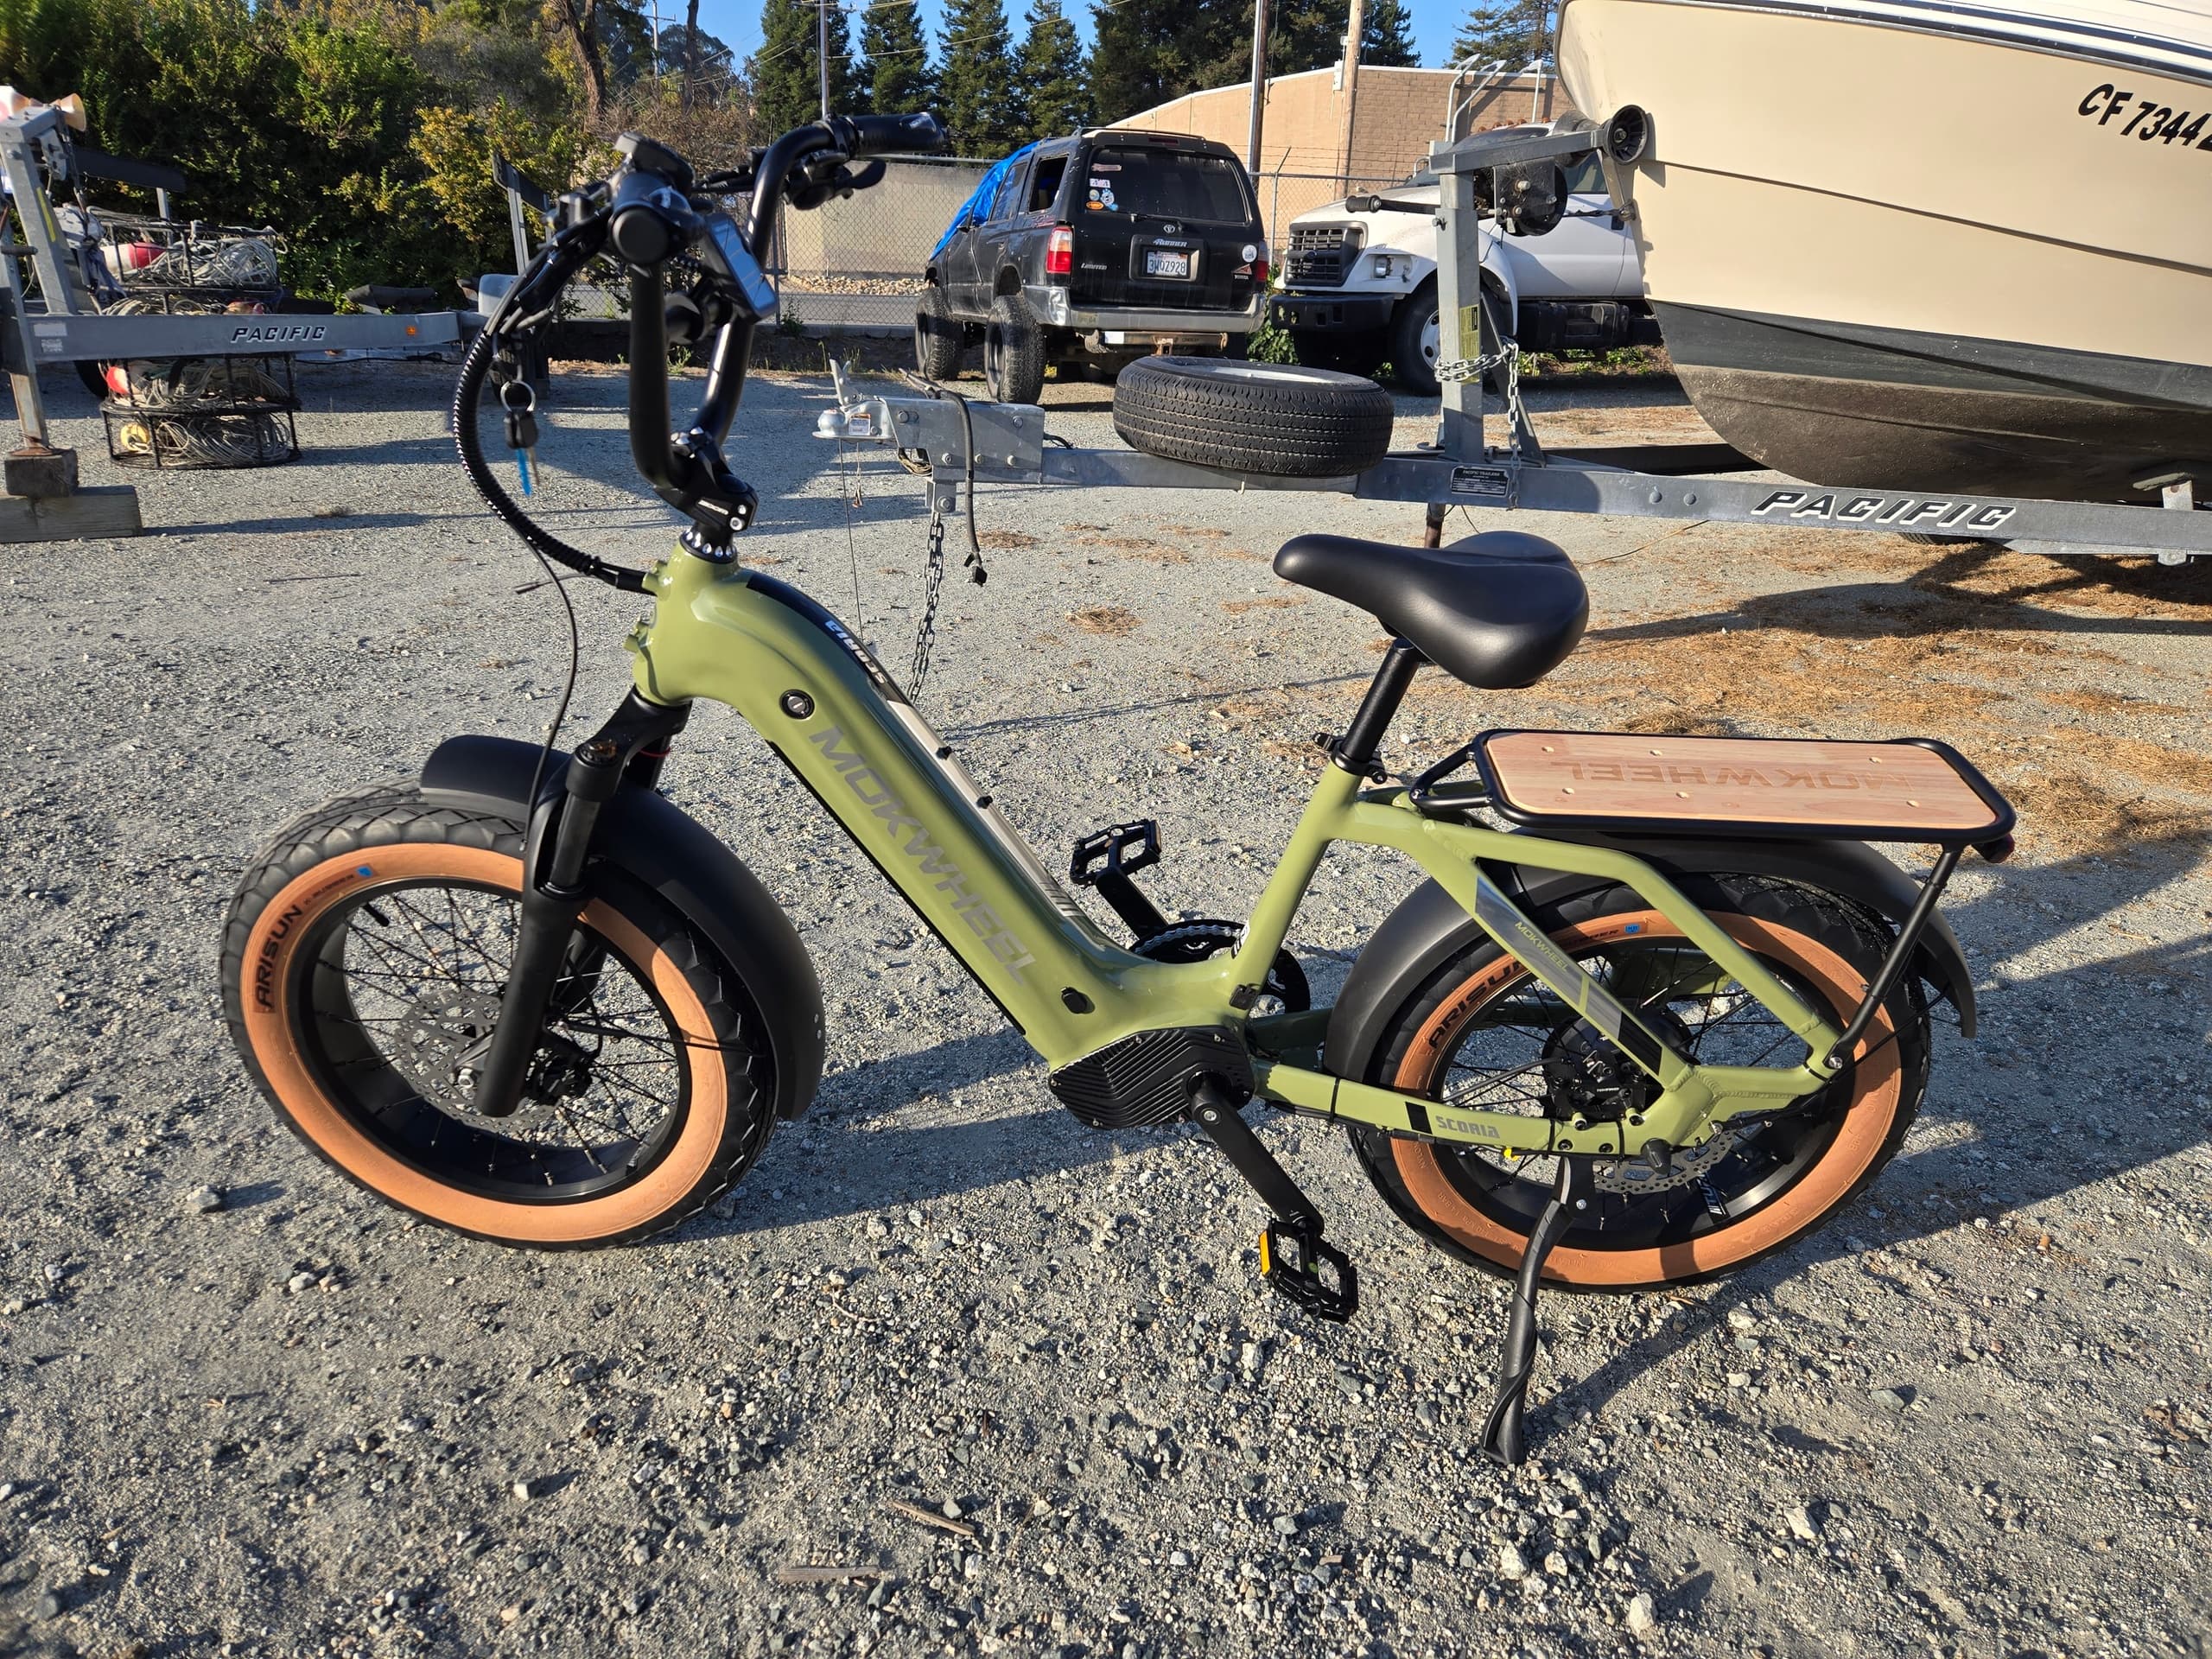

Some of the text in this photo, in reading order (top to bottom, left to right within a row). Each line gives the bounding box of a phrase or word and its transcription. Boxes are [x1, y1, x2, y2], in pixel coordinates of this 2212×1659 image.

[2078, 83, 2133, 125] CF
[230, 325, 326, 344] PACIFIC
[1750, 490, 2017, 531] PACIFIC
[1550, 760, 1915, 791] MOKWHEEL
[808, 724, 1037, 987] MOKWHEEL
[254, 904, 303, 1009] ARISUN
[1514, 921, 1568, 974] MOKWHEEL
[1434, 1115, 1501, 1140] SCORIA
